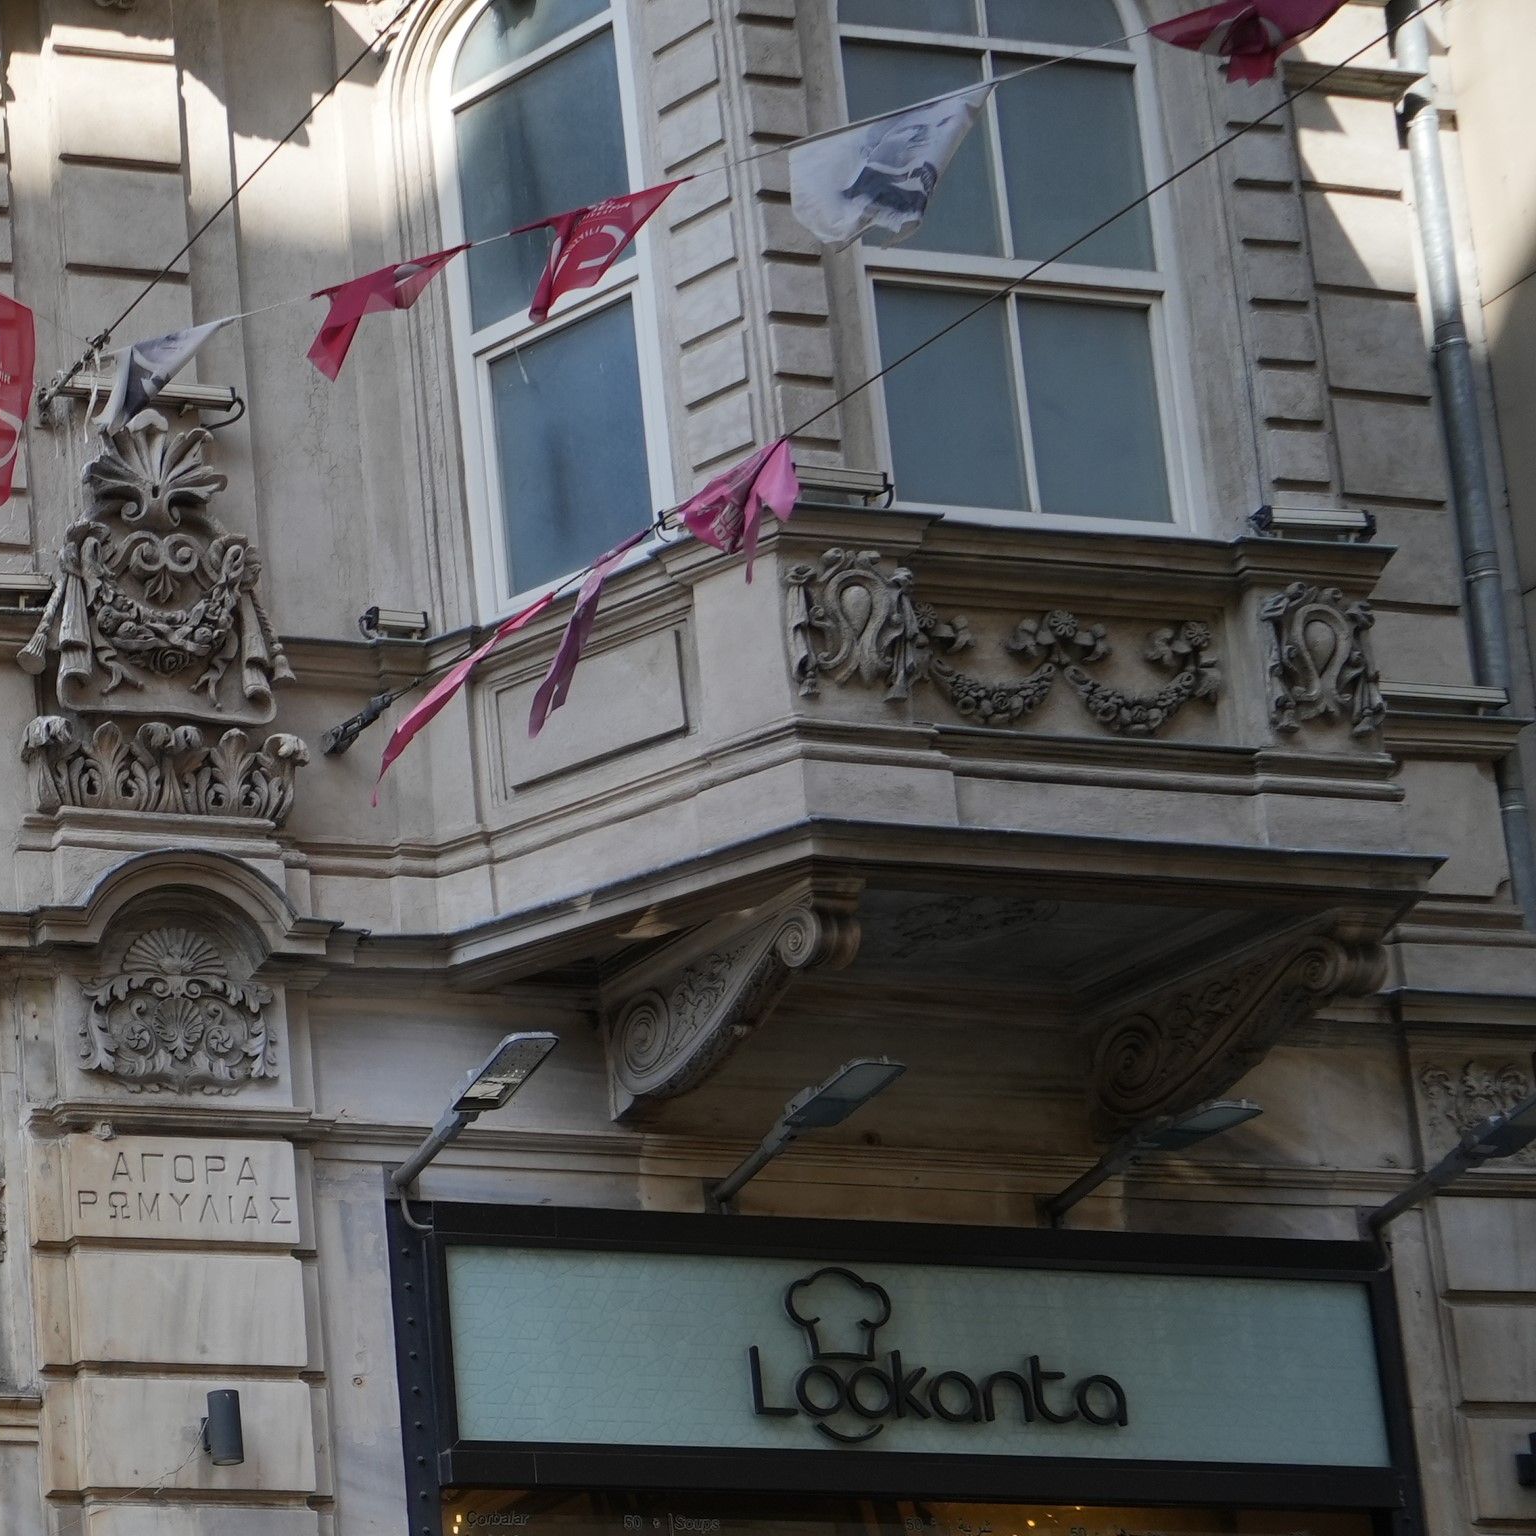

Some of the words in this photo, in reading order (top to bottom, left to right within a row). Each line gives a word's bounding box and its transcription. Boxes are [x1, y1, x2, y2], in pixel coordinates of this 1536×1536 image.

[111, 1152, 257, 1185] ΑΓΟΡΑ
[78, 1190, 292, 1225] ΡΩΜΥΛΙΑΣ
[748, 1344, 1129, 1429] Lookanta
[624, 1515, 642, 1529] 50
[674, 1516, 720, 1531] Soups
